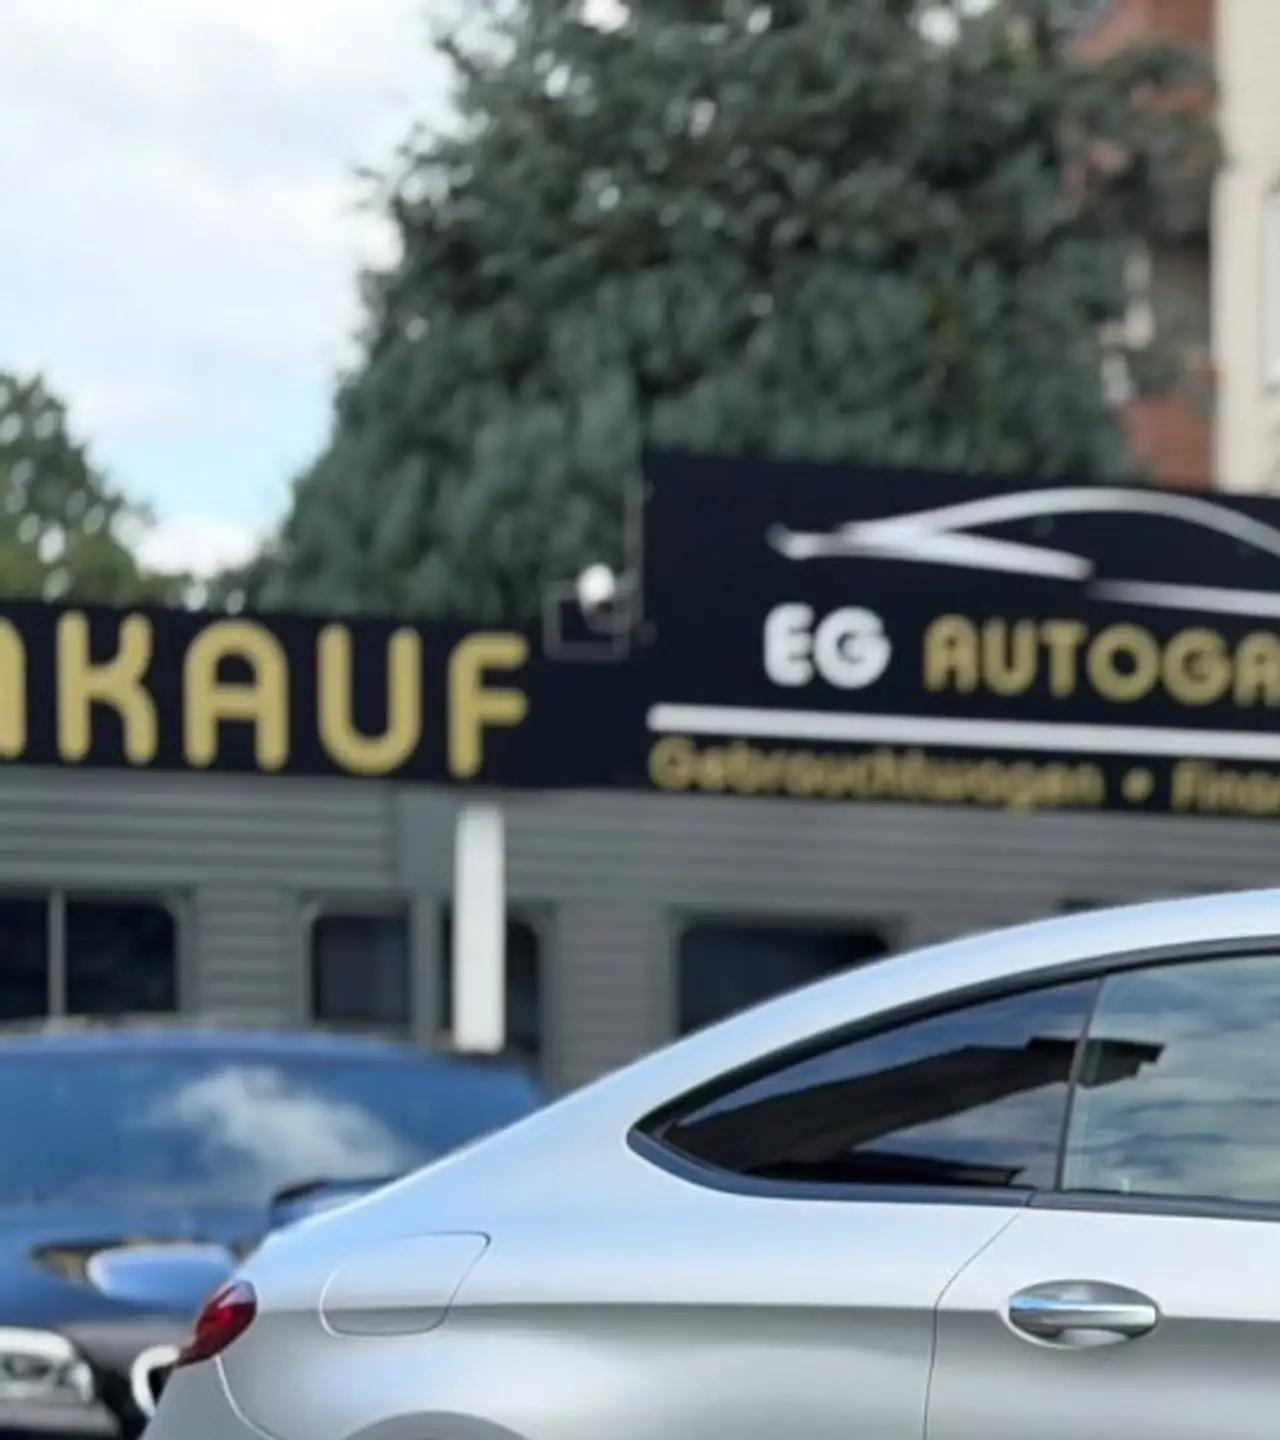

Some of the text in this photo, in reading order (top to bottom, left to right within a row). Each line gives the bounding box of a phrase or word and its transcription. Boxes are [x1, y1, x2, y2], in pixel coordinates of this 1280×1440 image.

[763, 602, 892, 690] EG
[0, 608, 529, 779] KAUF
[648, 735, 1106, 816] Gebrauchtwagen
